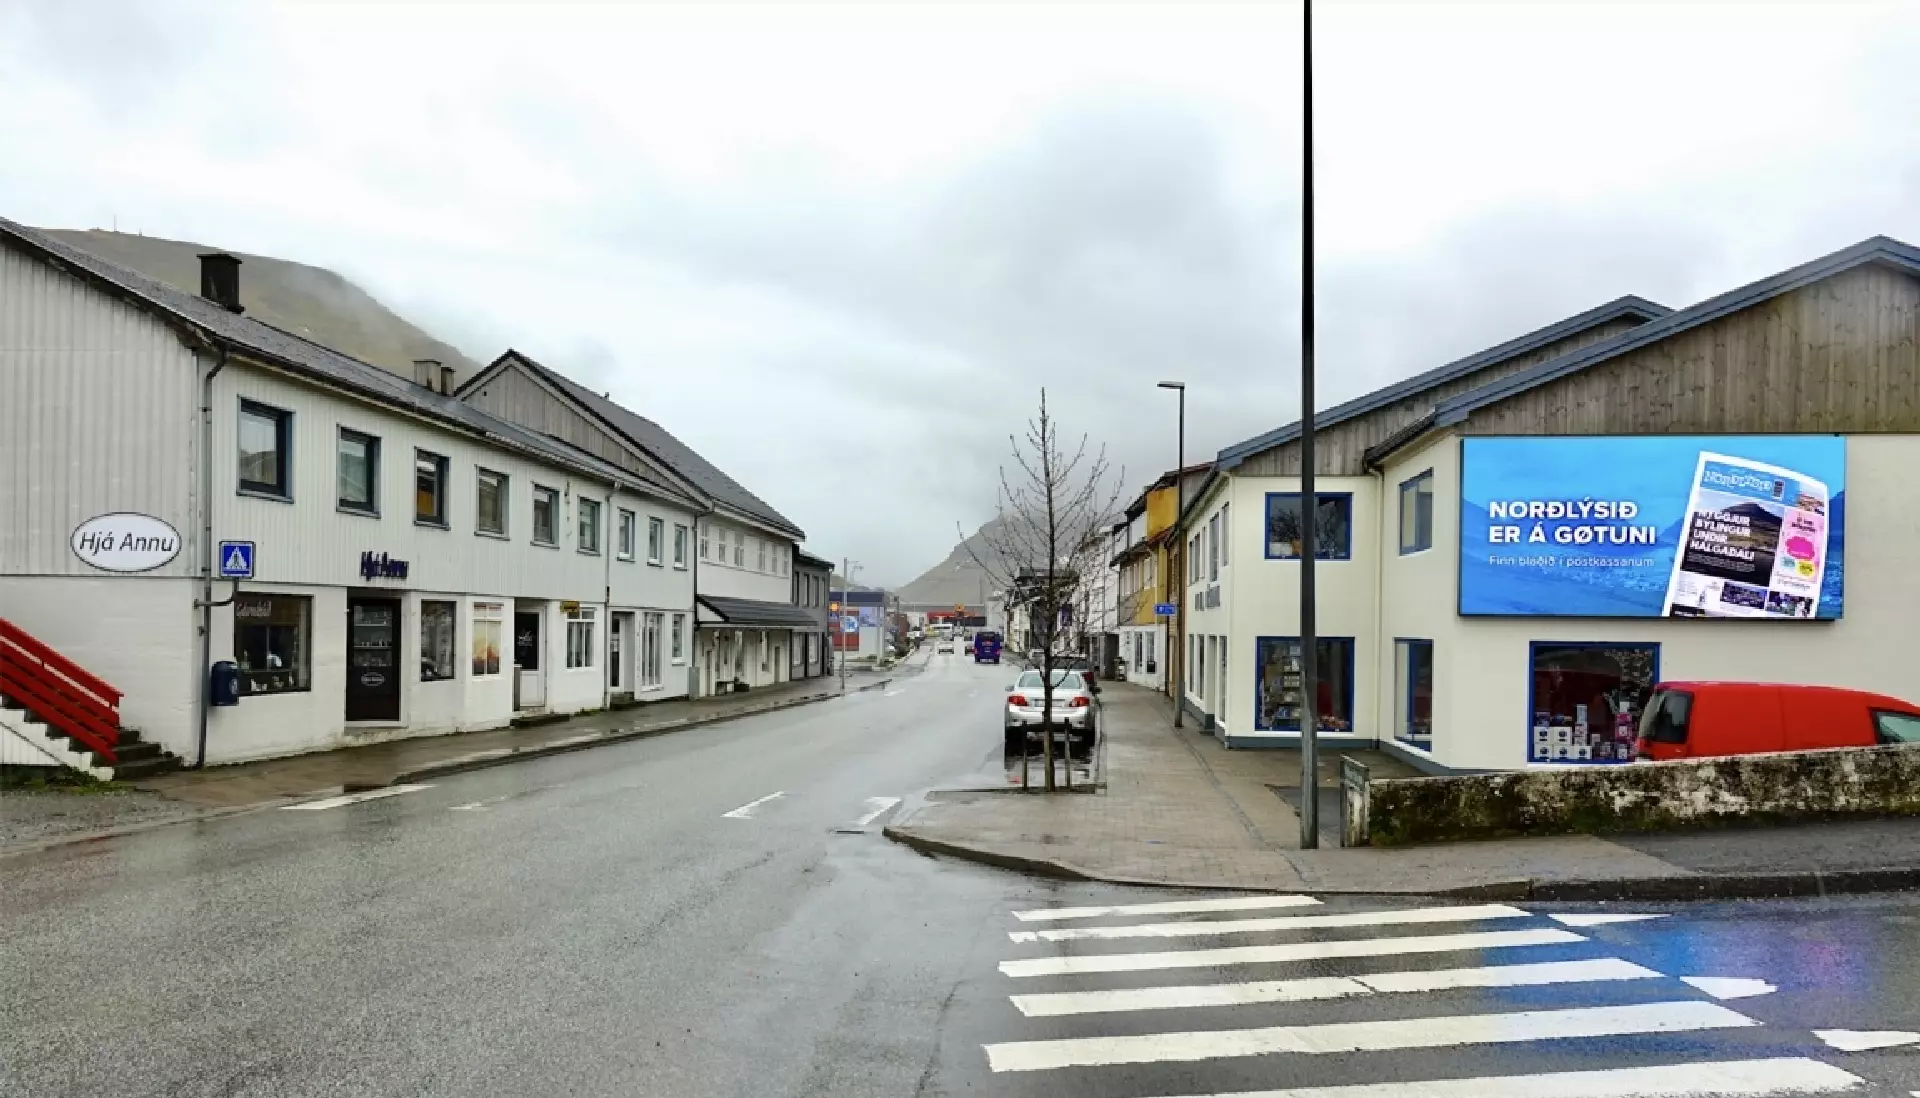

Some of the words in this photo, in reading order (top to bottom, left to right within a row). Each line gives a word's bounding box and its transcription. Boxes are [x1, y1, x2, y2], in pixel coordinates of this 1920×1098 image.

[1489, 496, 1638, 519] NORÐLÝSIÐ
[79, 531, 115, 556] Hjá
[119, 531, 175, 551] Annu
[1489, 526, 1521, 543] ER
[1528, 520, 1547, 543] Á
[1554, 525, 1656, 545] GØTUNI
[1489, 555, 1515, 566] Finn
[1566, 556, 1655, 568] postkassanum
